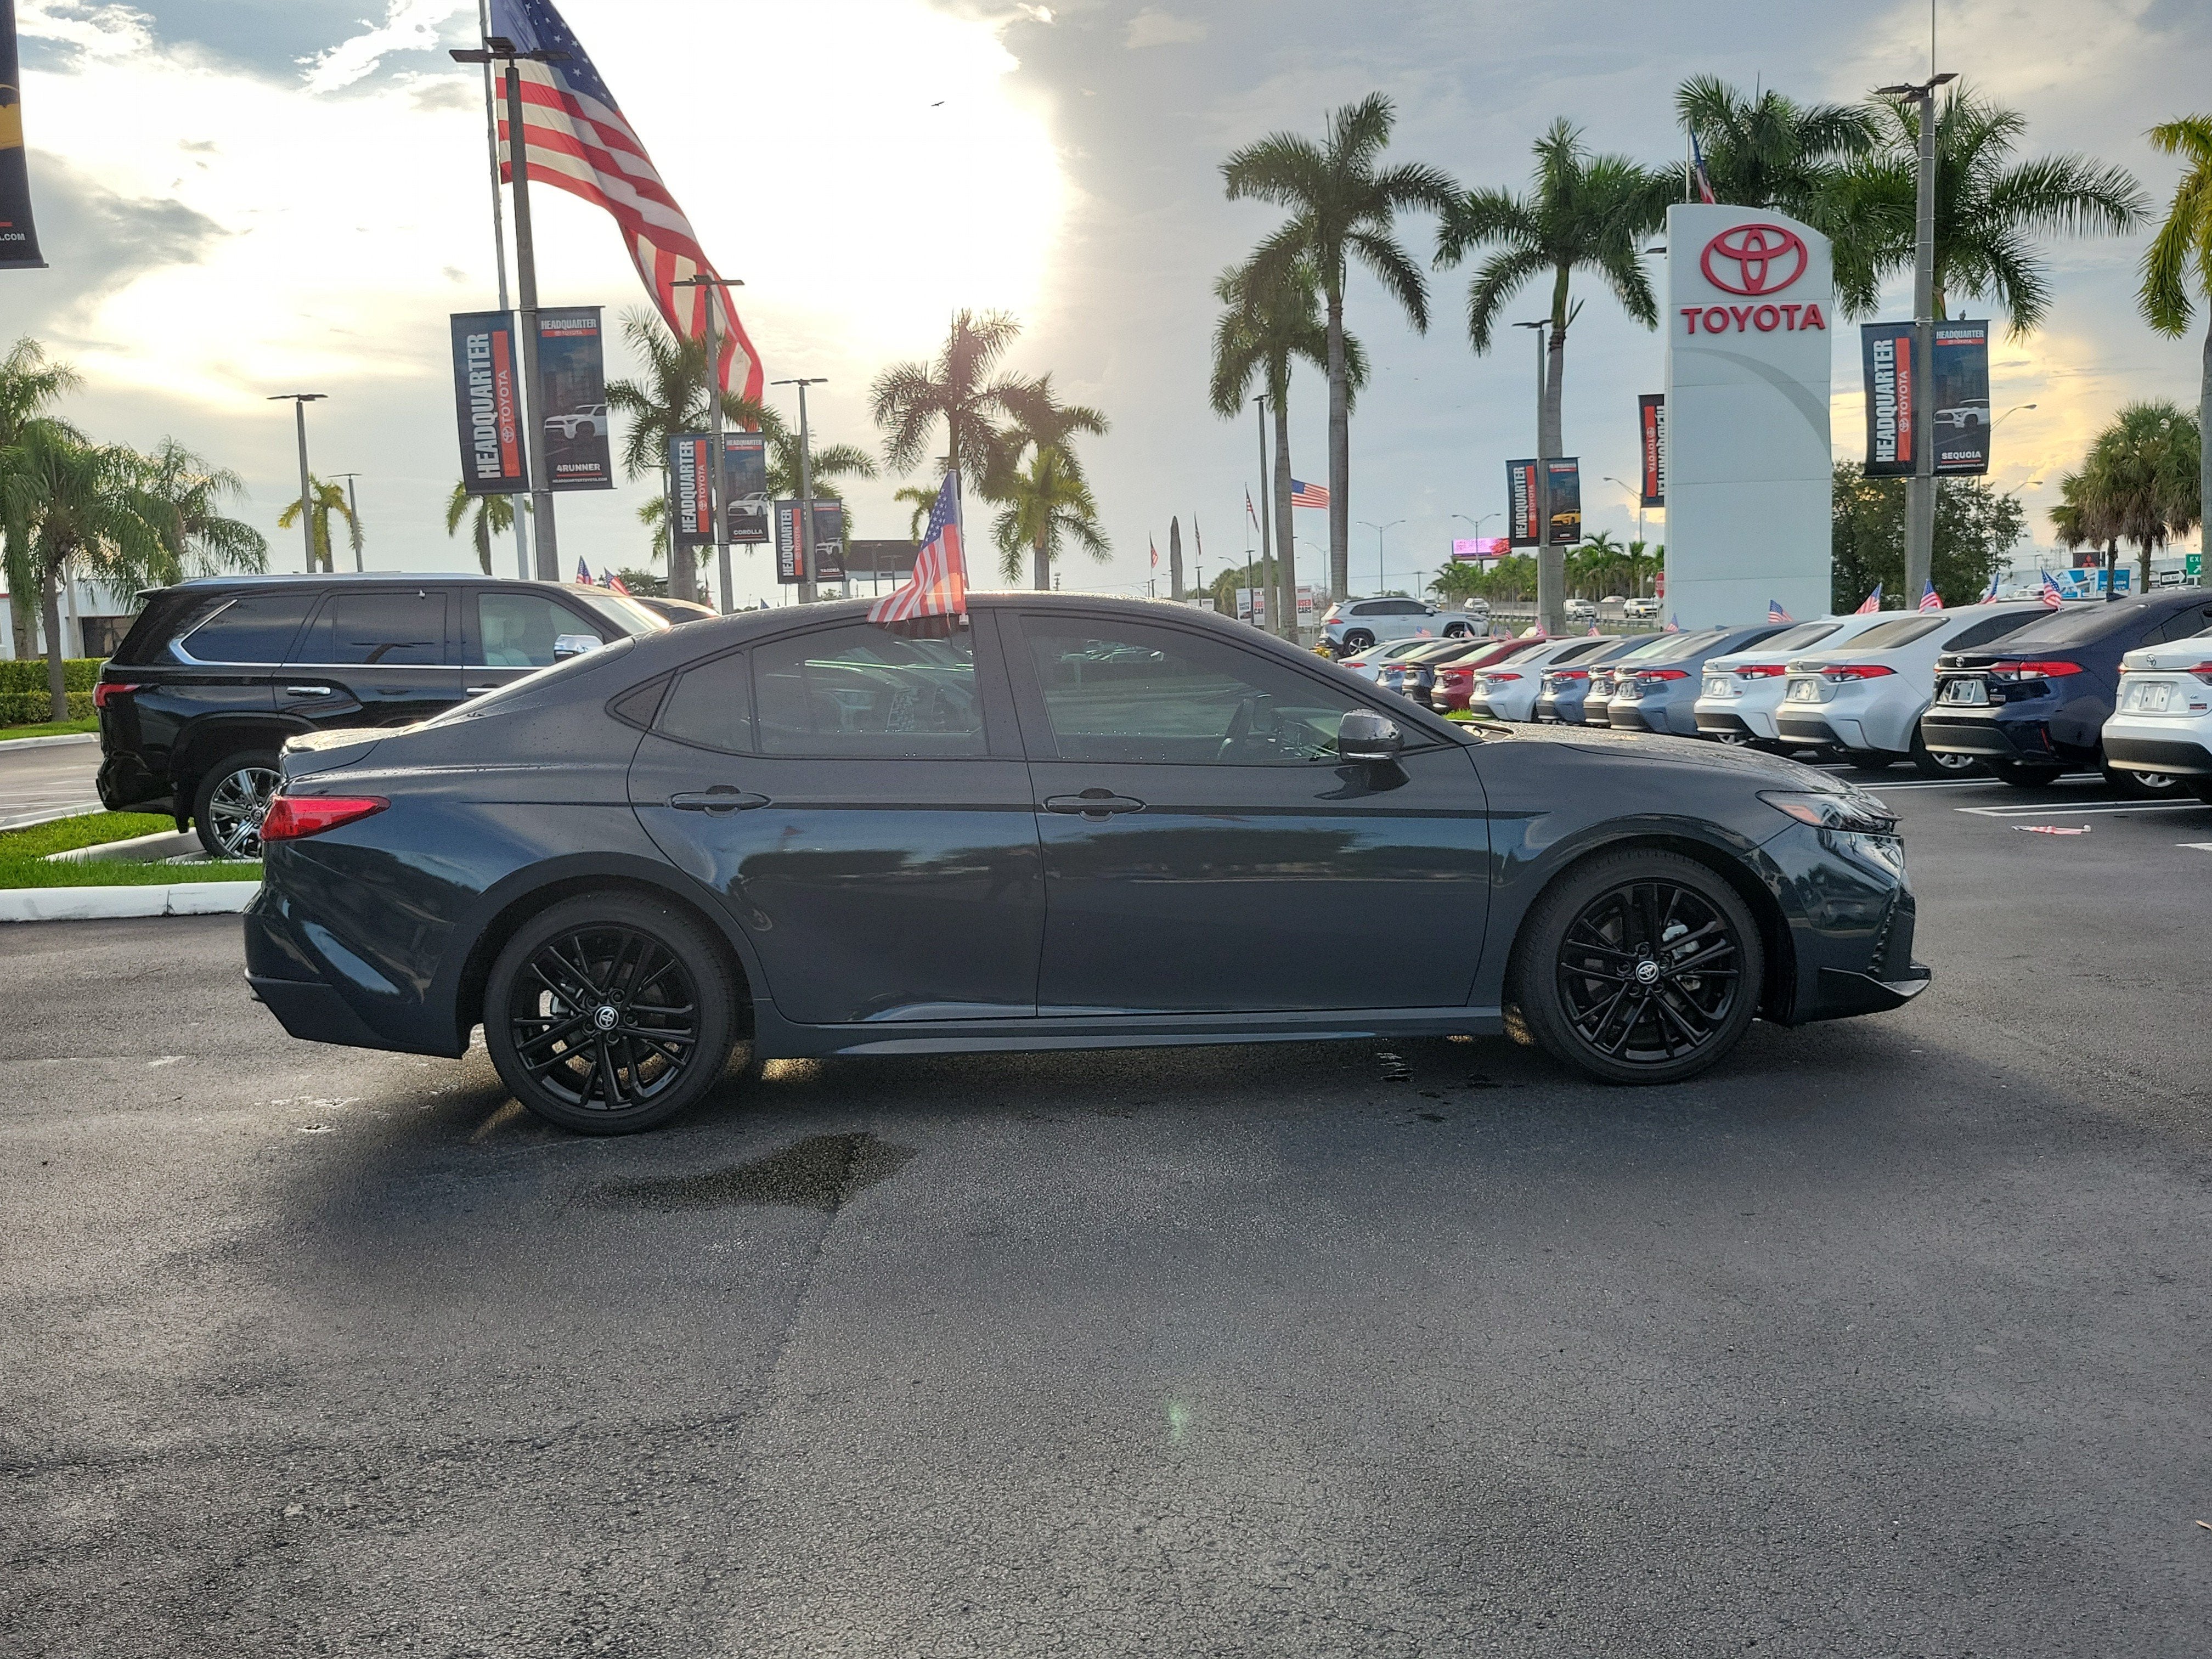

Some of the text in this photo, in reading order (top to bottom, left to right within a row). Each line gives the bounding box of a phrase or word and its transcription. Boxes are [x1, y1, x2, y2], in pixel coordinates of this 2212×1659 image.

[541, 319, 597, 330] HEADQUARTER
[1680, 304, 1826, 334] TOYOTA
[1936, 330, 1984, 340] HEADQUARTER
[466, 332, 501, 479] HEADQUARTER
[498, 370, 514, 425] TOYOTA
[1873, 338, 1898, 462] HEADQUARTER
[1899, 370, 1910, 417] TOYOTA
[556, 463, 601, 472] 4RUNNER
[1647, 438, 1656, 473] TOYOTA
[1942, 451, 1982, 460] SEQUOIA
[680, 441, 697, 533] HEADQUARTER
[697, 465, 706, 500] TOYOTA
[1513, 466, 1529, 539] HEADQUARTER
[781, 509, 794, 576] HEADQUARTER
